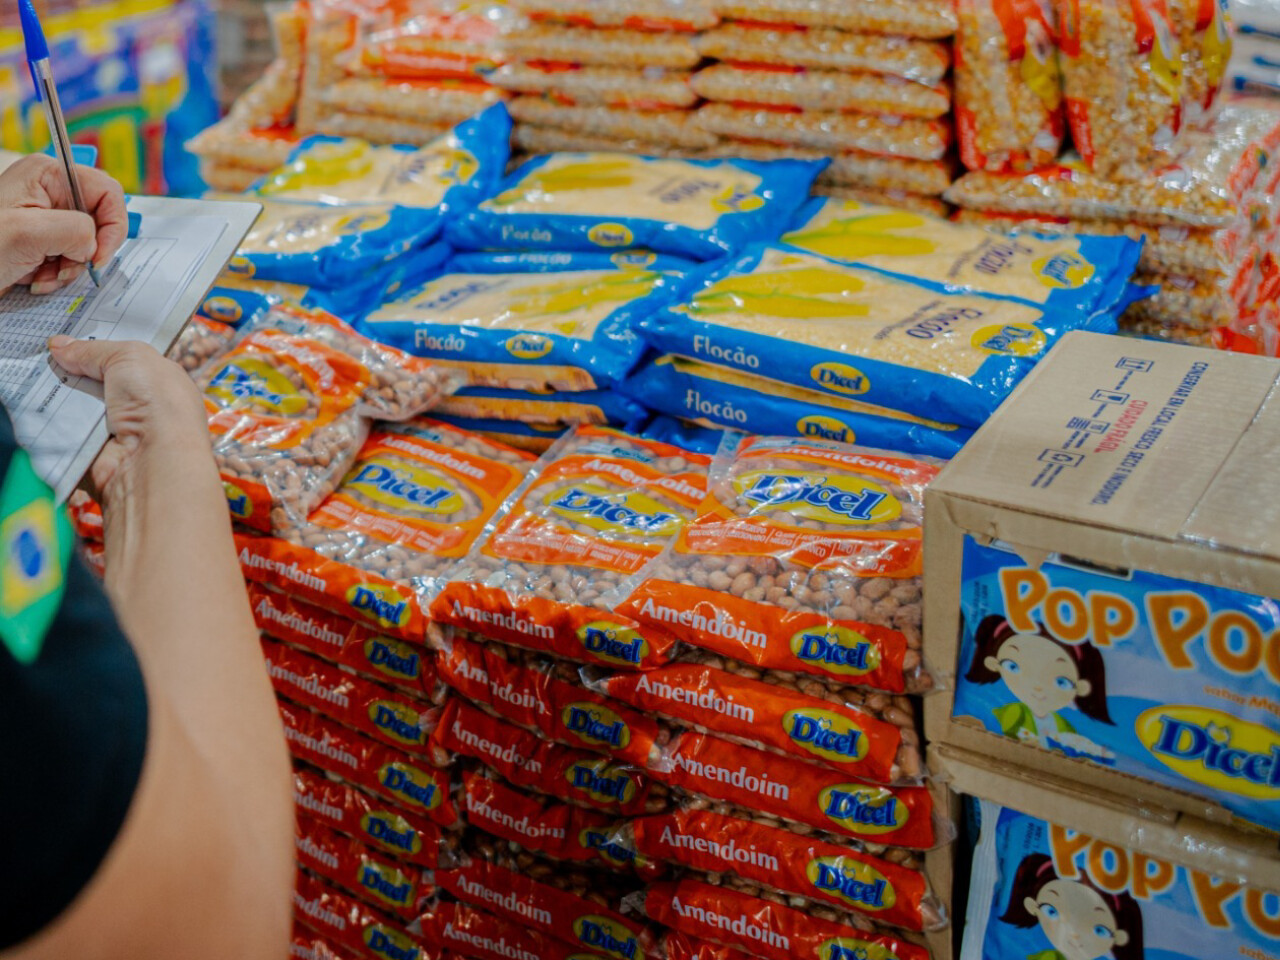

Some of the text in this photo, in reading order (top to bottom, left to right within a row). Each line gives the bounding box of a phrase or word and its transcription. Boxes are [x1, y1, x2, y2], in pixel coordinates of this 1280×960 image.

[414, 328, 466, 353] Flocão
[693, 334, 864, 392] Flocão Dicel
[685, 388, 850, 441] Flocão Dicel
[377, 435, 487, 481] Amendoim
[581, 458, 708, 501] Amenoim
[351, 463, 457, 510] Dicel
[548, 487, 680, 533] Dicel
[742, 473, 889, 521] Dicel
[238, 547, 408, 625] Amendoim Dicel
[254, 598, 420, 678] Amendoim Dicel
[448, 599, 644, 664] Amendoim Dicel
[639, 597, 871, 671] Amendoim Dicel
[567, 706, 625, 747] Dicel
[634, 673, 863, 759] Amendoim Dicel
[283, 725, 438, 809] mendoim Dicel
[451, 720, 543, 775] Amendom
[465, 791, 566, 841] Amendoim
[671, 751, 898, 827] Amendoim Dicel
[366, 816, 416, 852] Dicel
[659, 824, 888, 908] Amendoim Dicel
[442, 921, 542, 960] Amendoim
[455, 873, 639, 960] Amendoim Dicel
[670, 895, 791, 951] Amendoim
